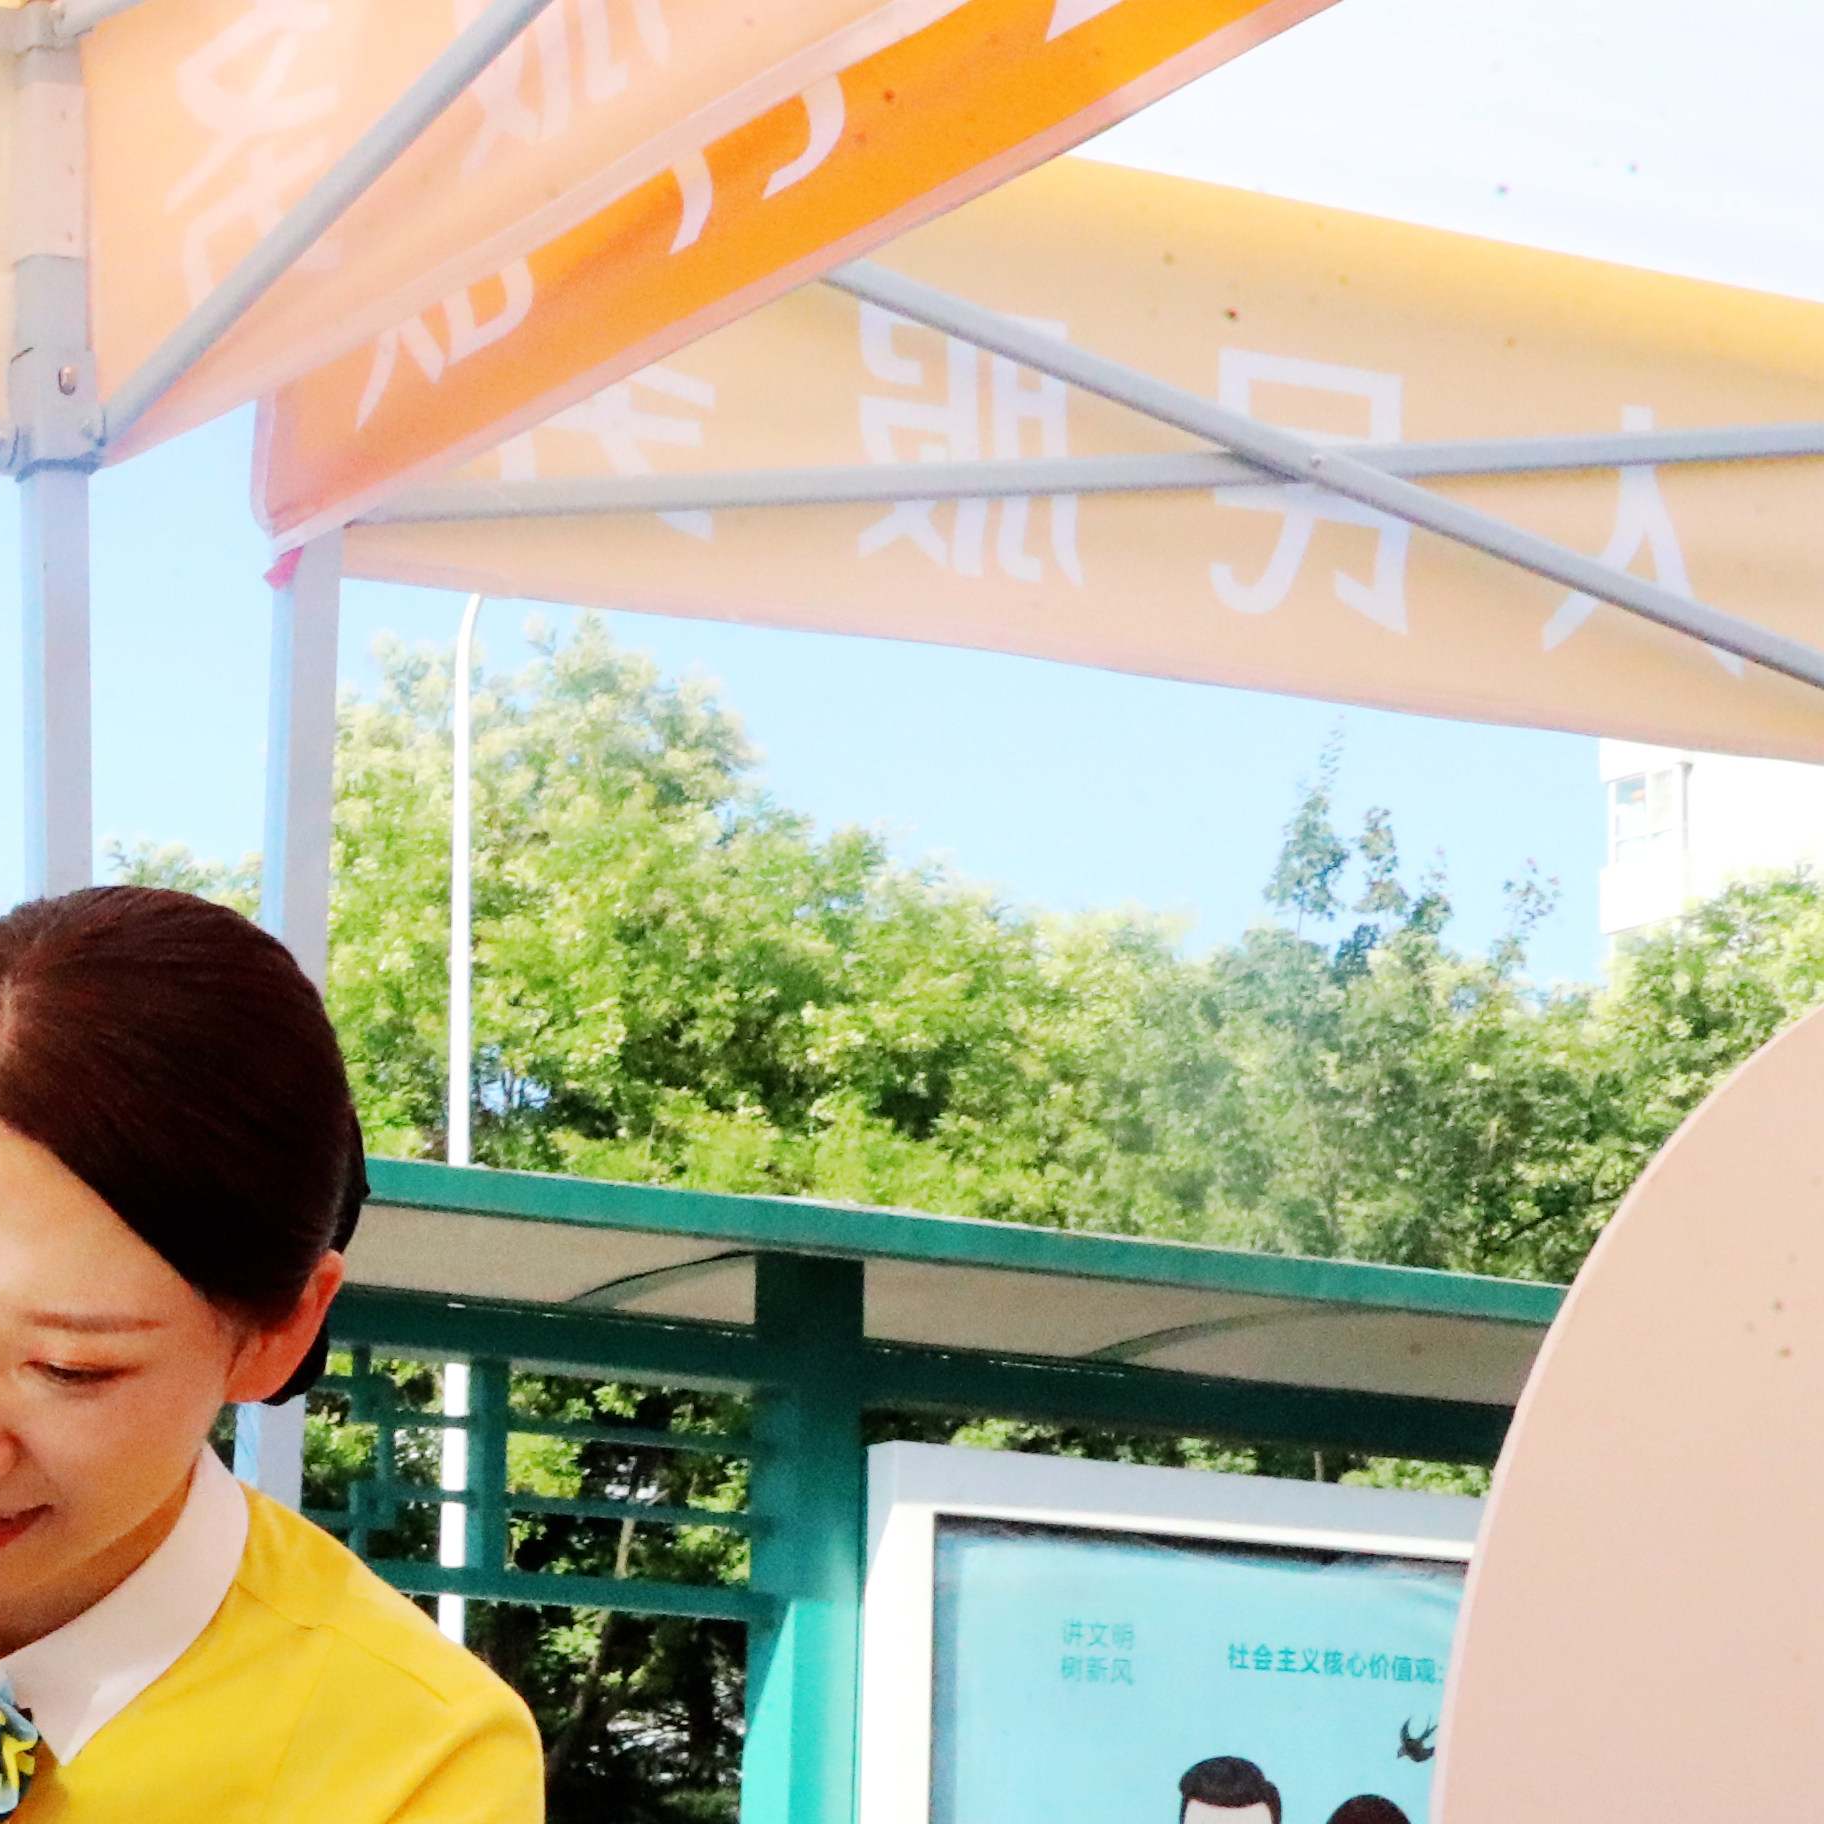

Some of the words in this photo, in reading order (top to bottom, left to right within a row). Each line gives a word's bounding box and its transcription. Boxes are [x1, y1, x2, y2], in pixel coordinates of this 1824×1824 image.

[1061, 1619, 1135, 1650] 讲文明
[1060, 1655, 1135, 1686] 树新风
